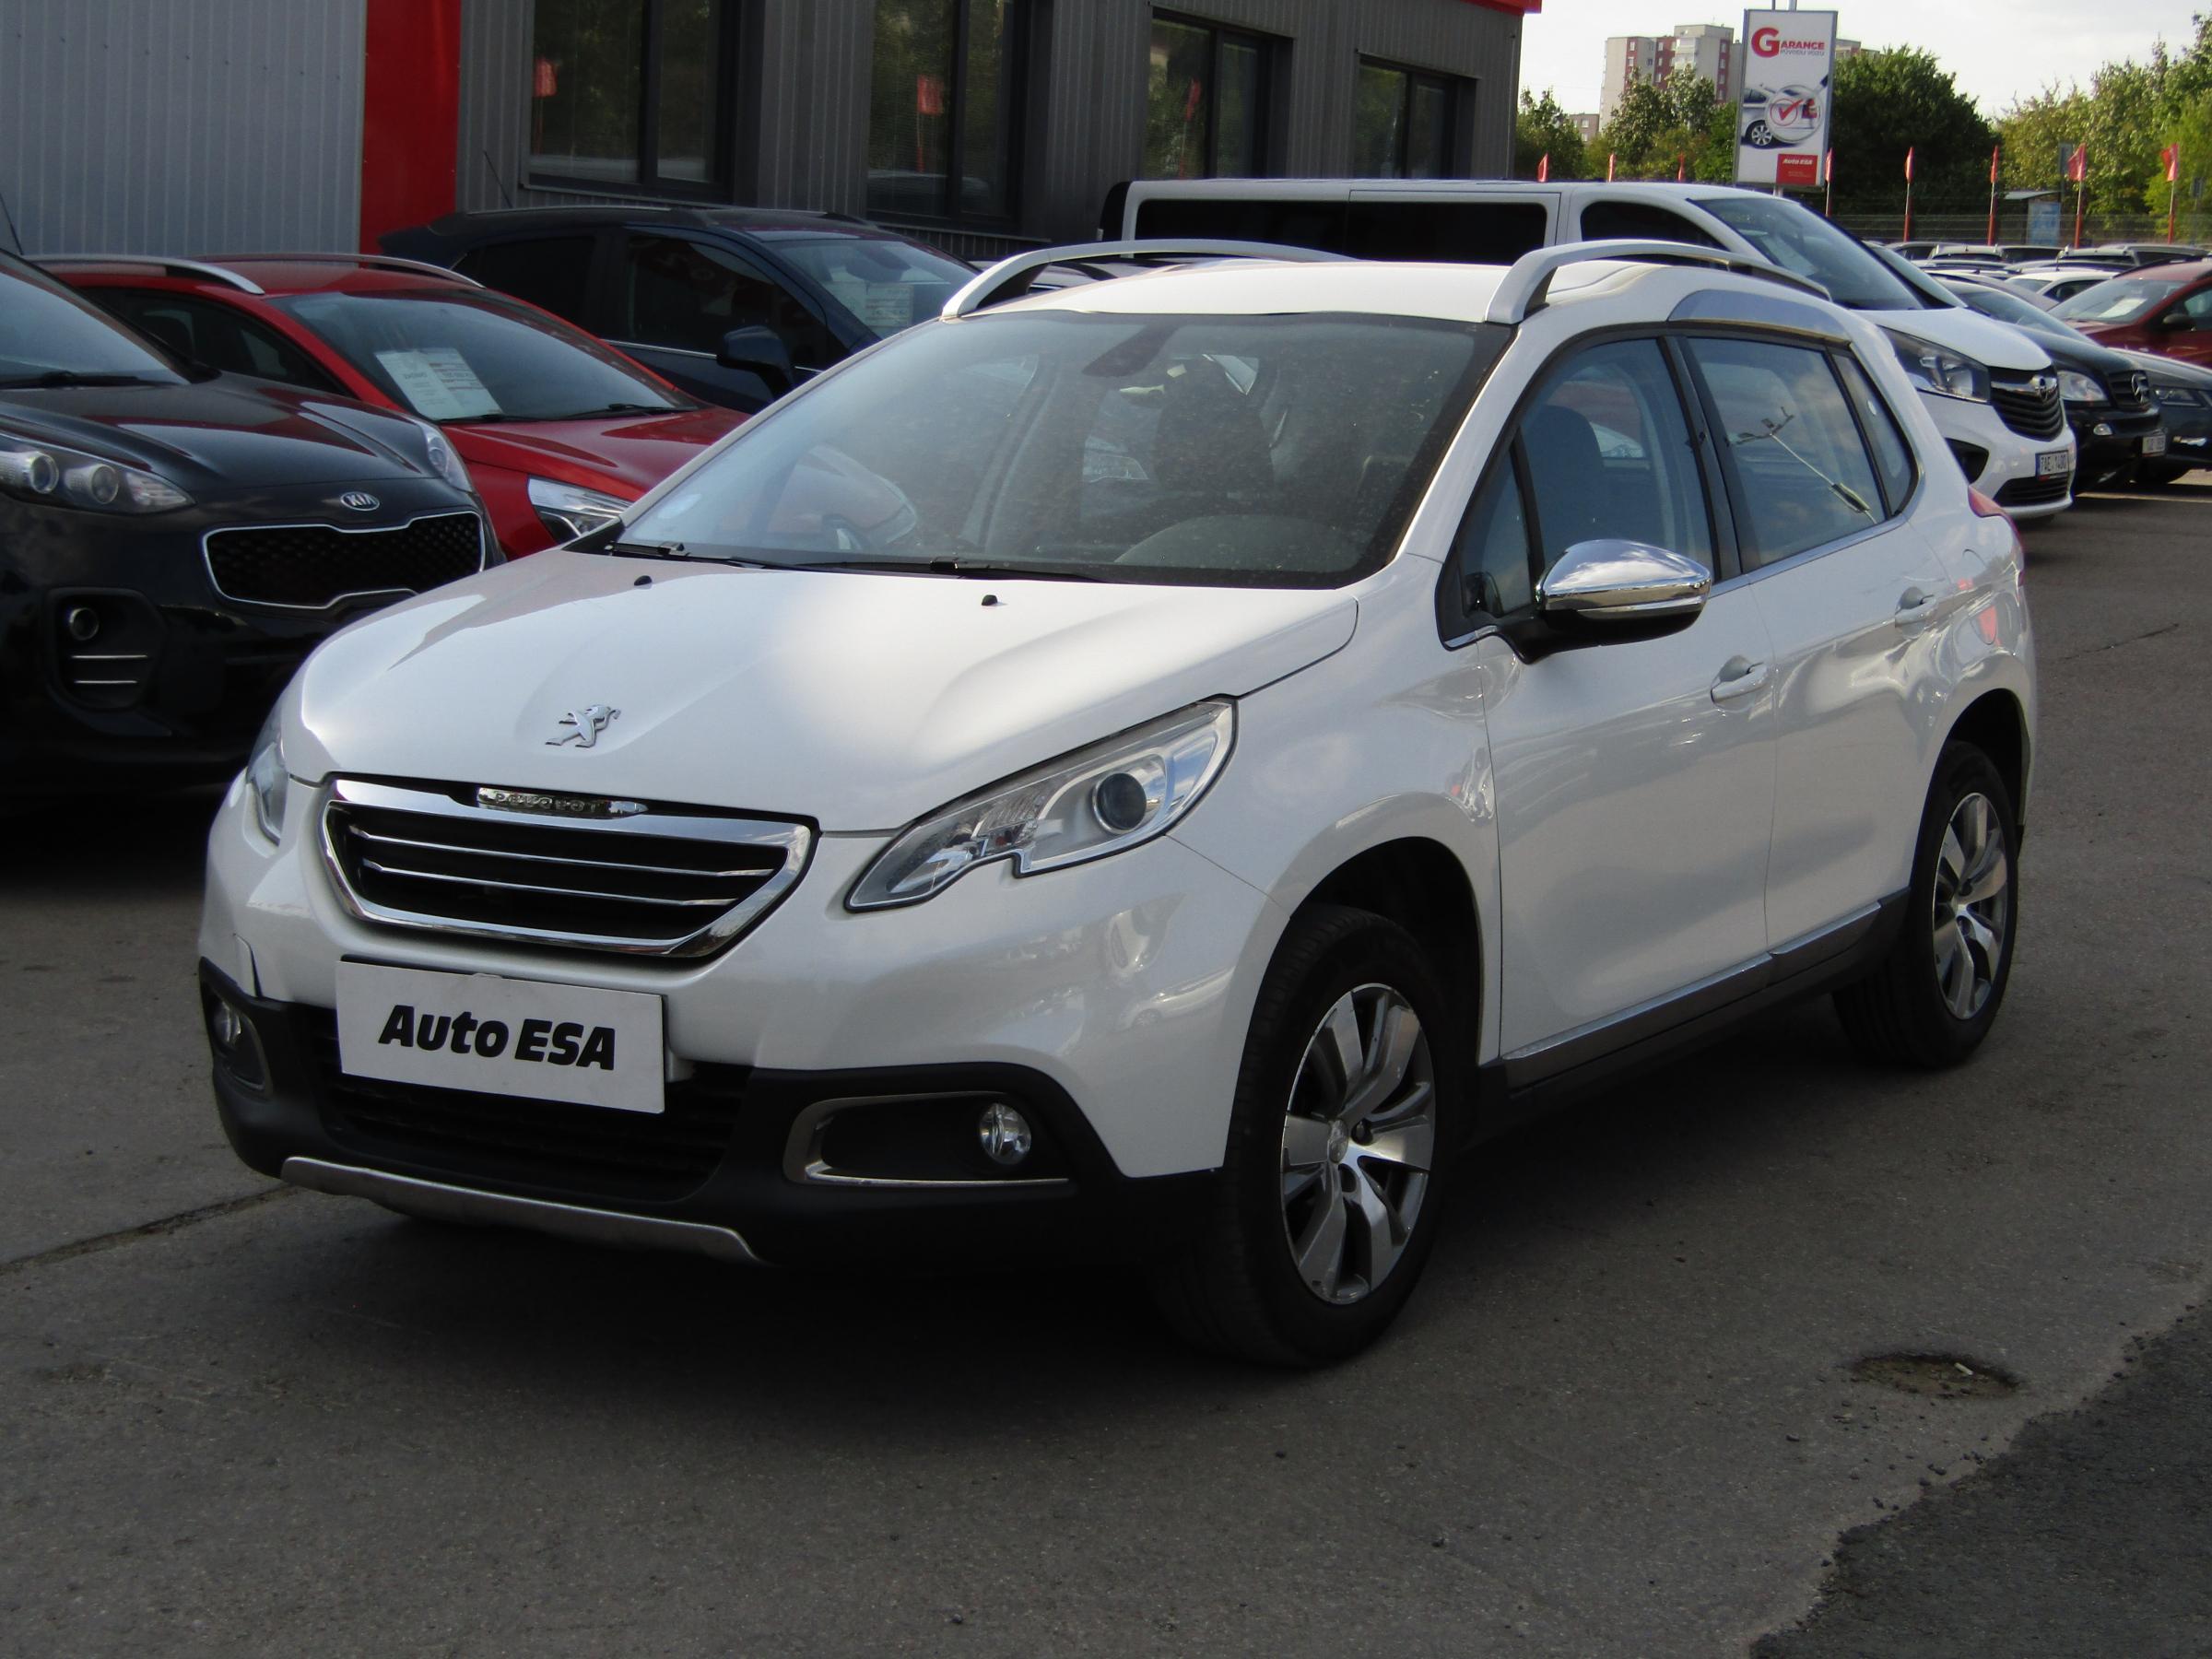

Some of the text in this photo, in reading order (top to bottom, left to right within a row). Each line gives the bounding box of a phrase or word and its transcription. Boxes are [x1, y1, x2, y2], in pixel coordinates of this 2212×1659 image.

[1751, 27, 1825, 58] GARANCE
[347, 494, 377, 506] KIA
[495, 793, 603, 813] PEUGEOT
[378, 1004, 616, 1071] Auto ESA
